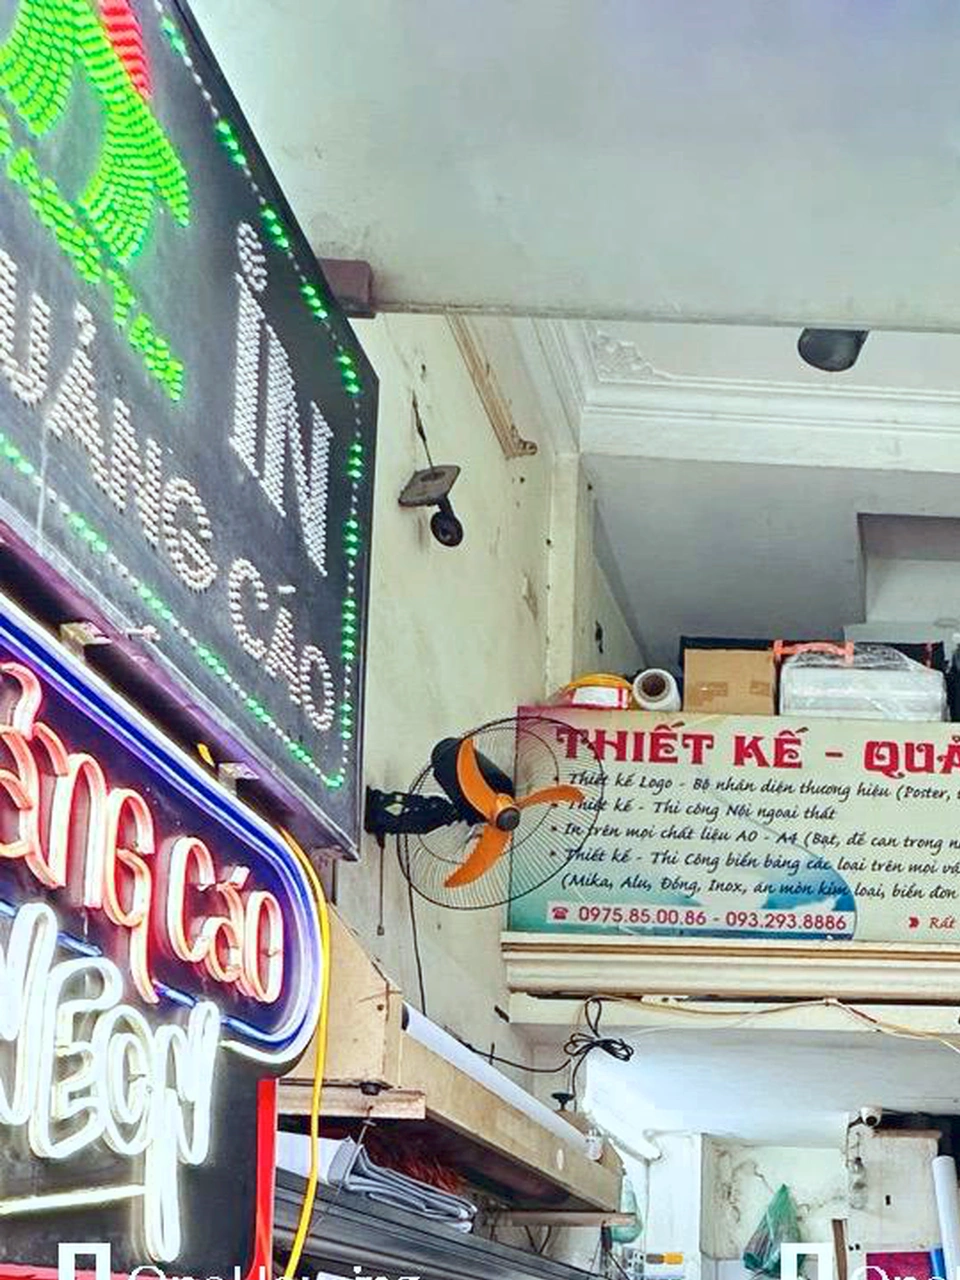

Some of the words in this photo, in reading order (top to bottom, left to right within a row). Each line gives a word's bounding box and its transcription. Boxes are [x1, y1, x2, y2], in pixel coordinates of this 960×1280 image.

[229, 558, 335, 732] CÁO
[555, 721, 714, 765] THIẾT
[734, 727, 809, 769] KẾ
[615, 773, 635, 787] kế
[639, 776, 673, 795] Logo
[896, 784, 951, 803] (Poster,
[614, 798, 634, 812] kế
[655, 801, 682, 814] Thi
[686, 804, 720, 822] công
[564, 823, 583, 835] In
[626, 826, 655, 841] mọi
[661, 825, 694, 840] chất
[701, 826, 731, 843] liệu
[871, 837, 899, 848] can
[903, 836, 943, 856] trong
[612, 848, 632, 863] kế
[652, 851, 680, 865] Thi
[685, 853, 720, 873] Công
[871, 860, 906, 873] trên
[561, 872, 613, 890] (Mika,
[620, 873, 652, 891] Alu,
[708, 879, 748, 895] Inox,
[818, 881, 850, 896] kim
[578, 906, 707, 926] 0975.85.00.86
[725, 911, 847, 930] 093.293.8886
[929, 915, 956, 930] Rất
